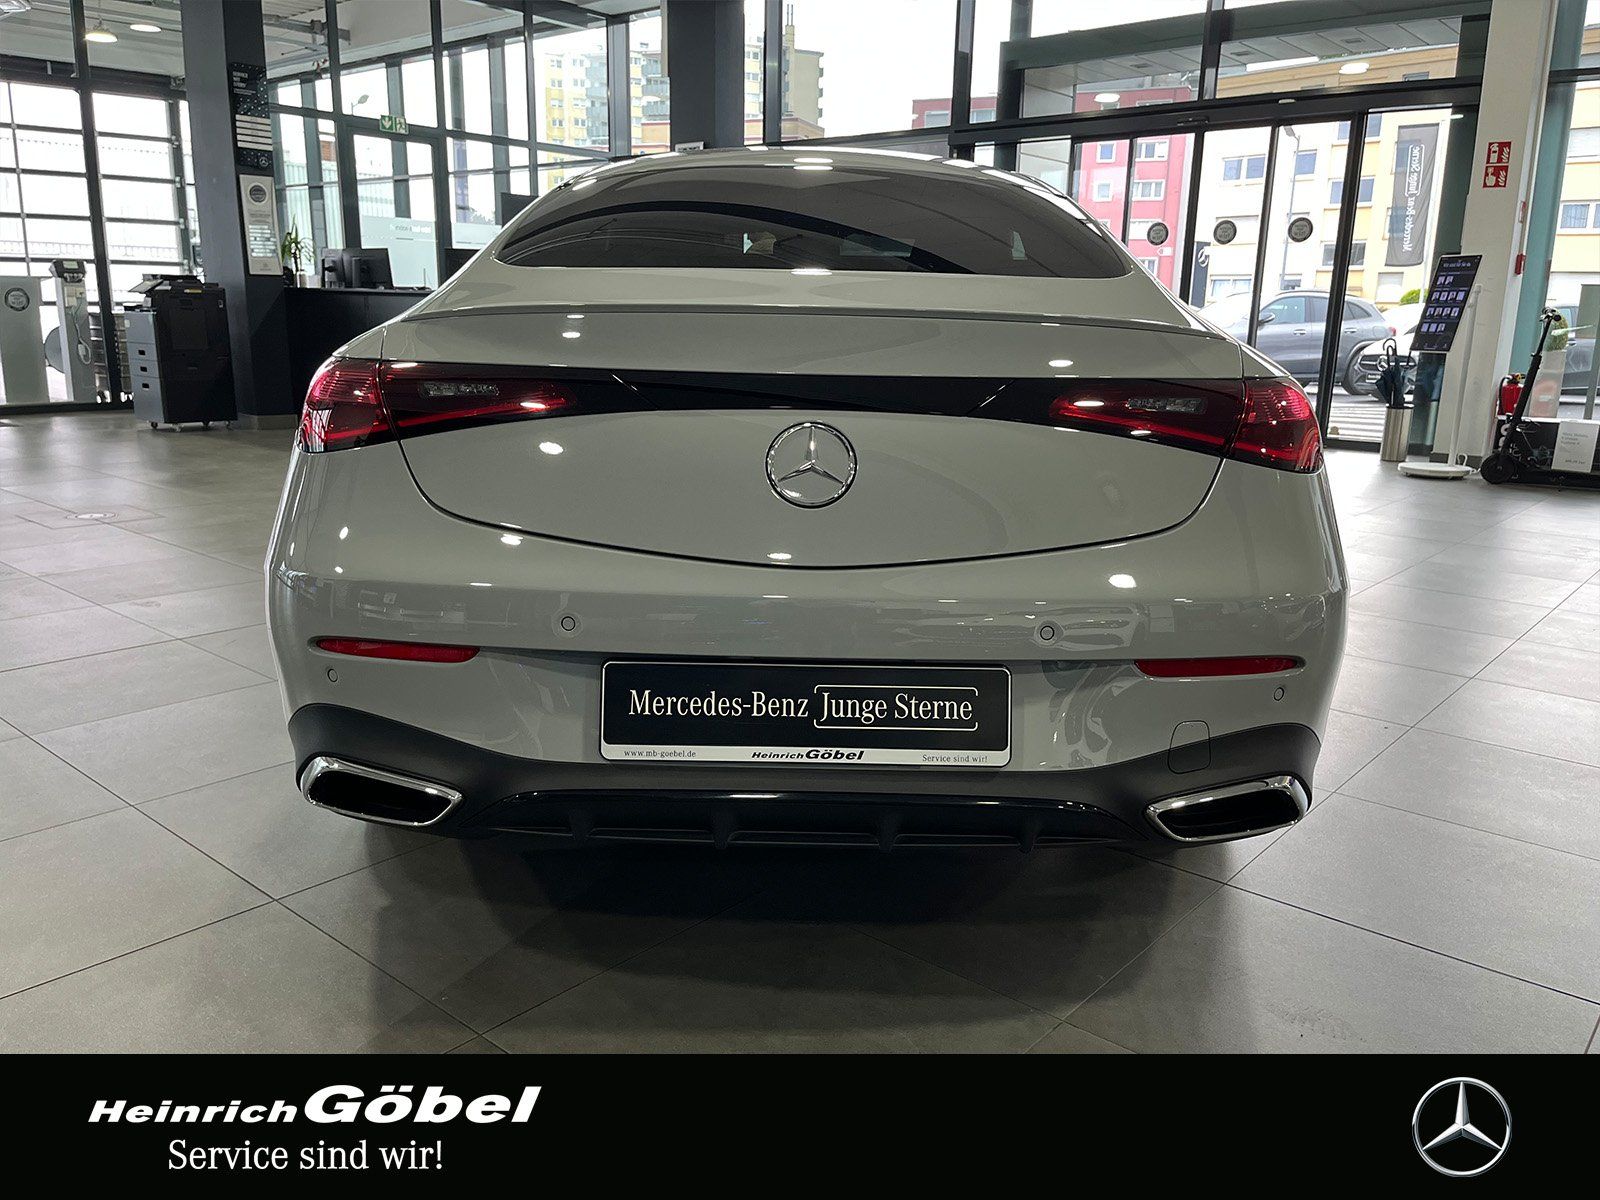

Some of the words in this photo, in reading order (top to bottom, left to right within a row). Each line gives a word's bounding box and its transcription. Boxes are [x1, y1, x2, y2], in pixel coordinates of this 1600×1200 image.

[628, 689, 809, 718] Mercedes-Benz
[820, 692, 888, 725] Junge
[894, 693, 973, 720] Sterne
[624, 749, 696, 759] www.mb-goebel.de
[922, 754, 951, 762] Service
[953, 755, 970, 763] sind
